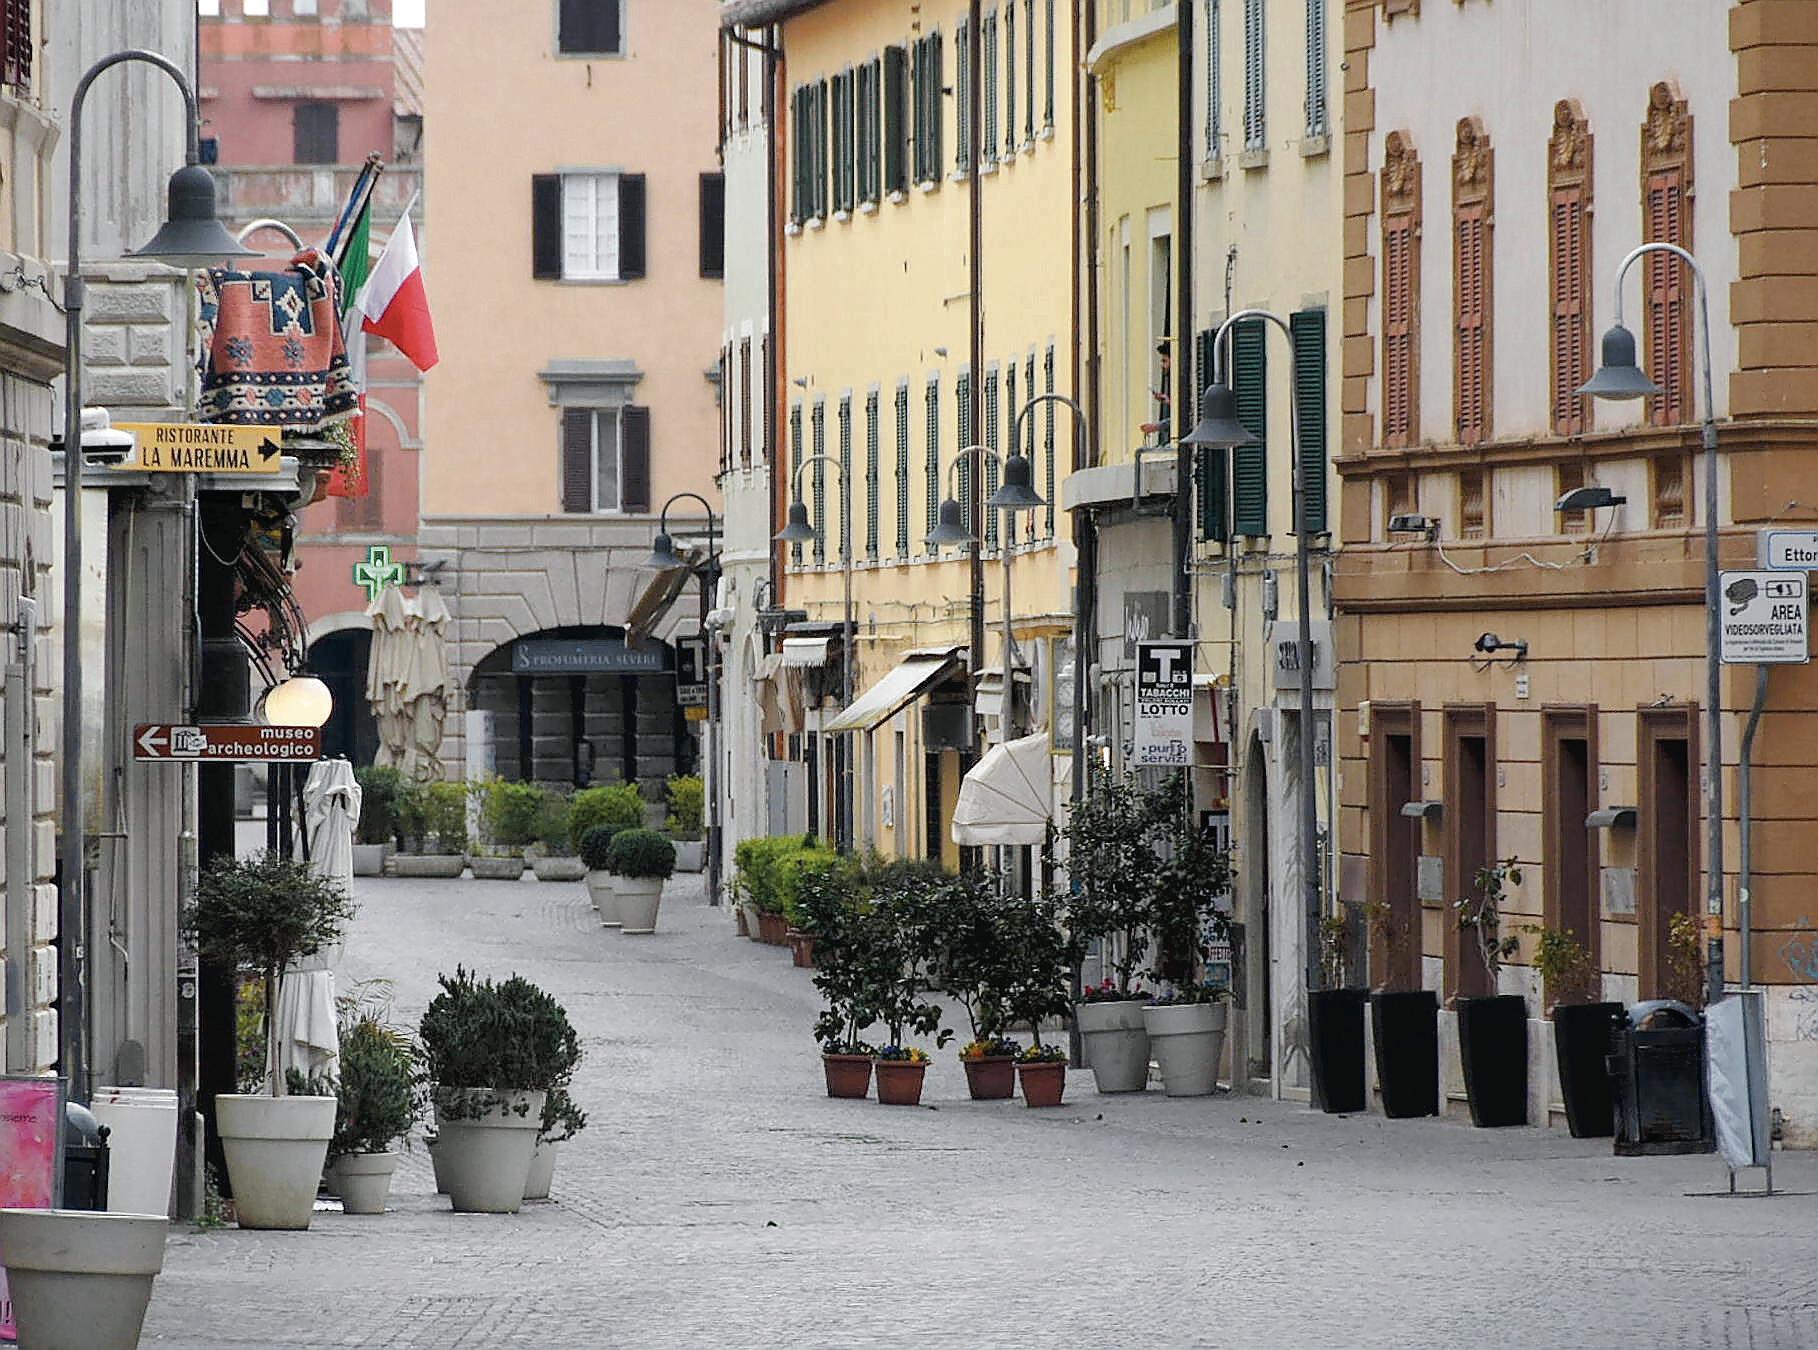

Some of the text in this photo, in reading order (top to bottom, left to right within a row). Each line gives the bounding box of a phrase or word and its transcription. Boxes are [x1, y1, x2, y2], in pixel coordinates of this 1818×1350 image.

[156, 427, 234, 445] RISTORANTE
[142, 447, 250, 469] LA MAREMMA
[1771, 604, 1802, 621] AREA
[1725, 623, 1804, 636] VIDEOSORVEGLIATA
[534, 652, 611, 666] PROFUMERIA
[1150, 649, 1181, 683] T
[1140, 688, 1191, 698] TABACCHI
[1141, 704, 1188, 716] LOTTO
[260, 728, 314, 740] museo
[207, 741, 314, 757] archeologico
[1141, 754, 1188, 764] servizi
